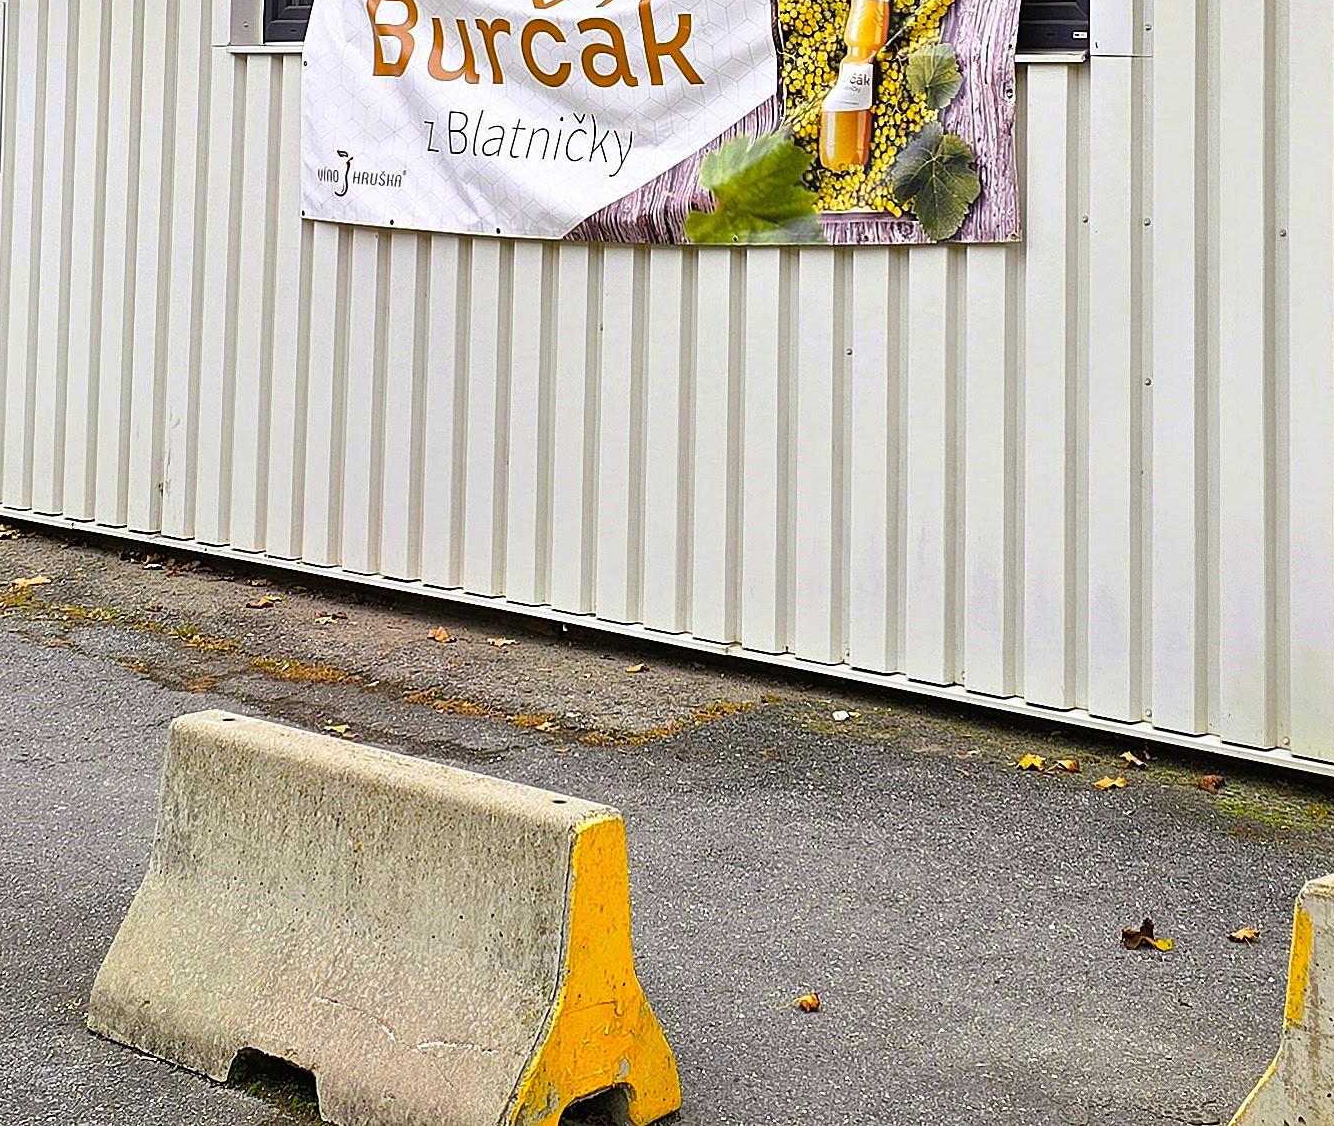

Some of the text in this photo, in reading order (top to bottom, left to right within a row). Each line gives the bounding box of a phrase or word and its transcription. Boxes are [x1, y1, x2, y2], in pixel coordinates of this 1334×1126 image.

[423, 109, 634, 178] z Blatničky
[317, 167, 340, 184] VÍNO
